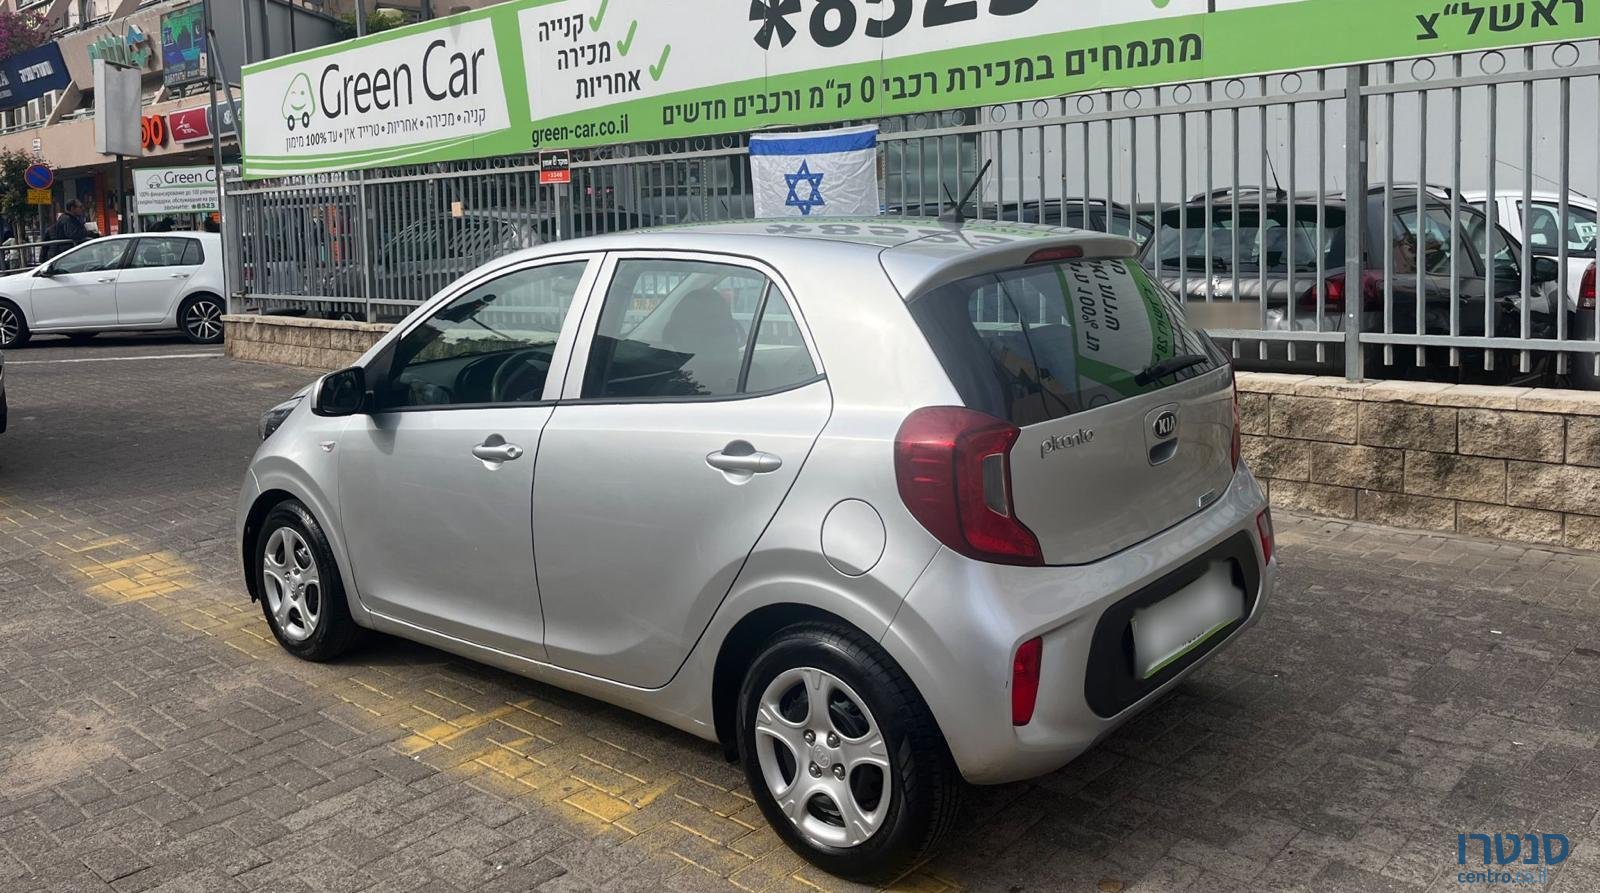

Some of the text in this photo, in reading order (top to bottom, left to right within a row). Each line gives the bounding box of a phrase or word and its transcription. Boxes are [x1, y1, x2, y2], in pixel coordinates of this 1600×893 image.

[538, 13, 584, 42] קנייה
[557, 41, 611, 70] מכירה
[1065, 33, 1202, 77] מתמחים
[319, 39, 485, 119] Green Car
[575, 69, 641, 100] אחריות
[882, 71, 938, 101] רכבי
[946, 54, 1055, 93] במכירת
[733, 89, 801, 118] ורכבים
[860, 74, 876, 104] 0
[386, 118, 418, 135] אחריות
[426, 112, 455, 129] מכירה
[463, 108, 486, 126] קניה
[662, 98, 727, 126] חדשים
[285, 135, 304, 152] מימון
[306, 132, 327, 147] 100%
[343, 127, 355, 144] אין
[357, 123, 380, 138] טרייד
[531, 113, 629, 148] green-car.co.il
[164, 171, 202, 184] Green
[1157, 415, 1178, 435] KIA
[1040, 428, 1095, 459] picanto
